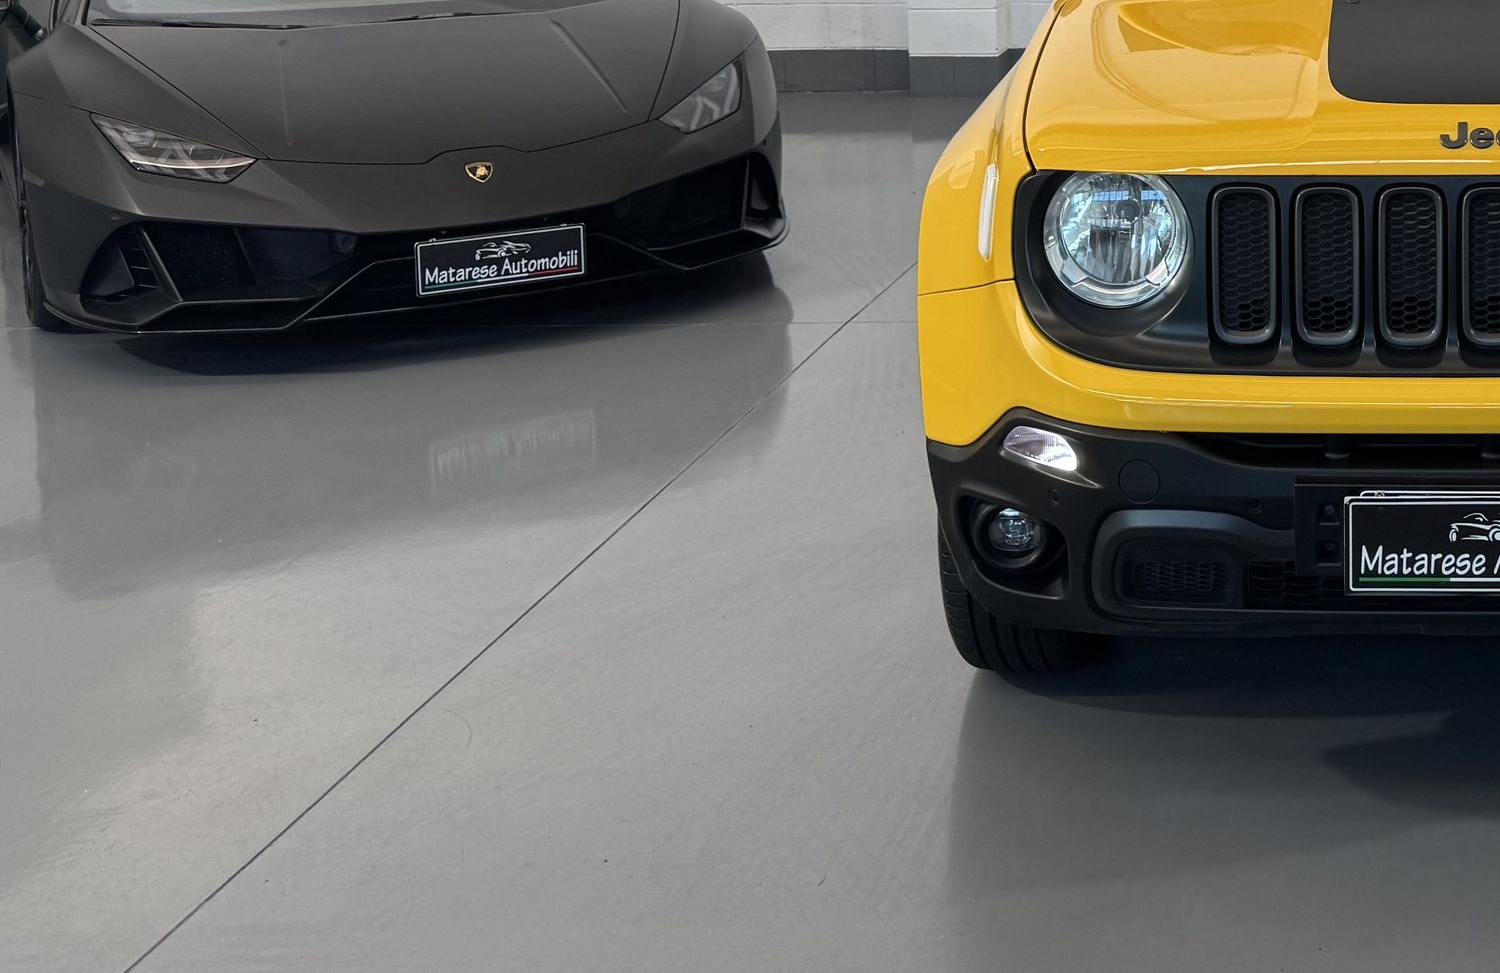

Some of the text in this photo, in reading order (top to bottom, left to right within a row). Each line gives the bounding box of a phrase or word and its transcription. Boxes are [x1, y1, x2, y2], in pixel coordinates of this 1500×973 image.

[425, 249, 578, 286] Matarese Automobili
[1360, 545, 1487, 575] Matarese
